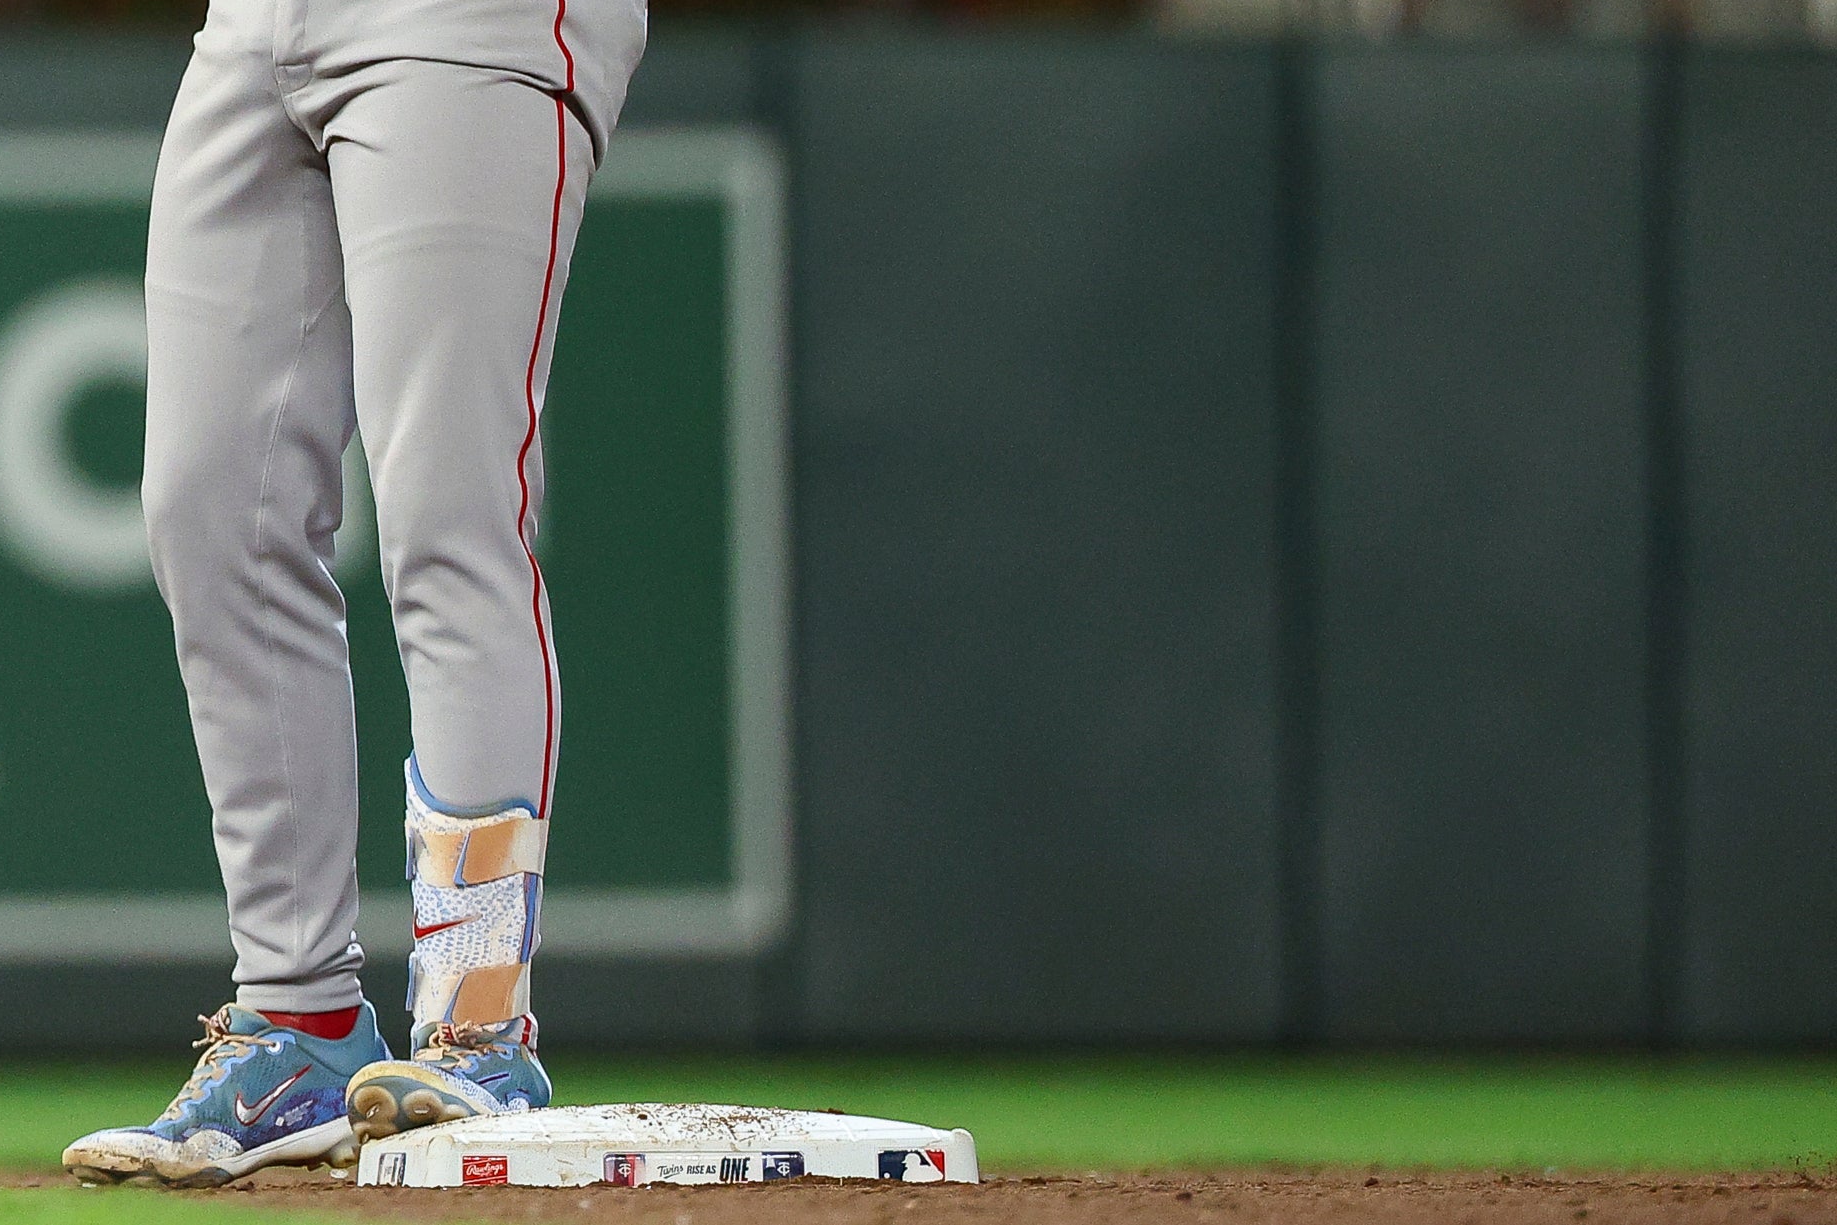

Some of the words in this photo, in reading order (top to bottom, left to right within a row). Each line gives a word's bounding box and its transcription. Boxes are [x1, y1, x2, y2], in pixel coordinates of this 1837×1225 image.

[466, 1162, 504, 1176] Rawlings
[656, 1165, 684, 1179] Twins
[686, 1165, 705, 1175] RISE
[705, 1165, 716, 1175] AS
[719, 1157, 751, 1183] ONE
